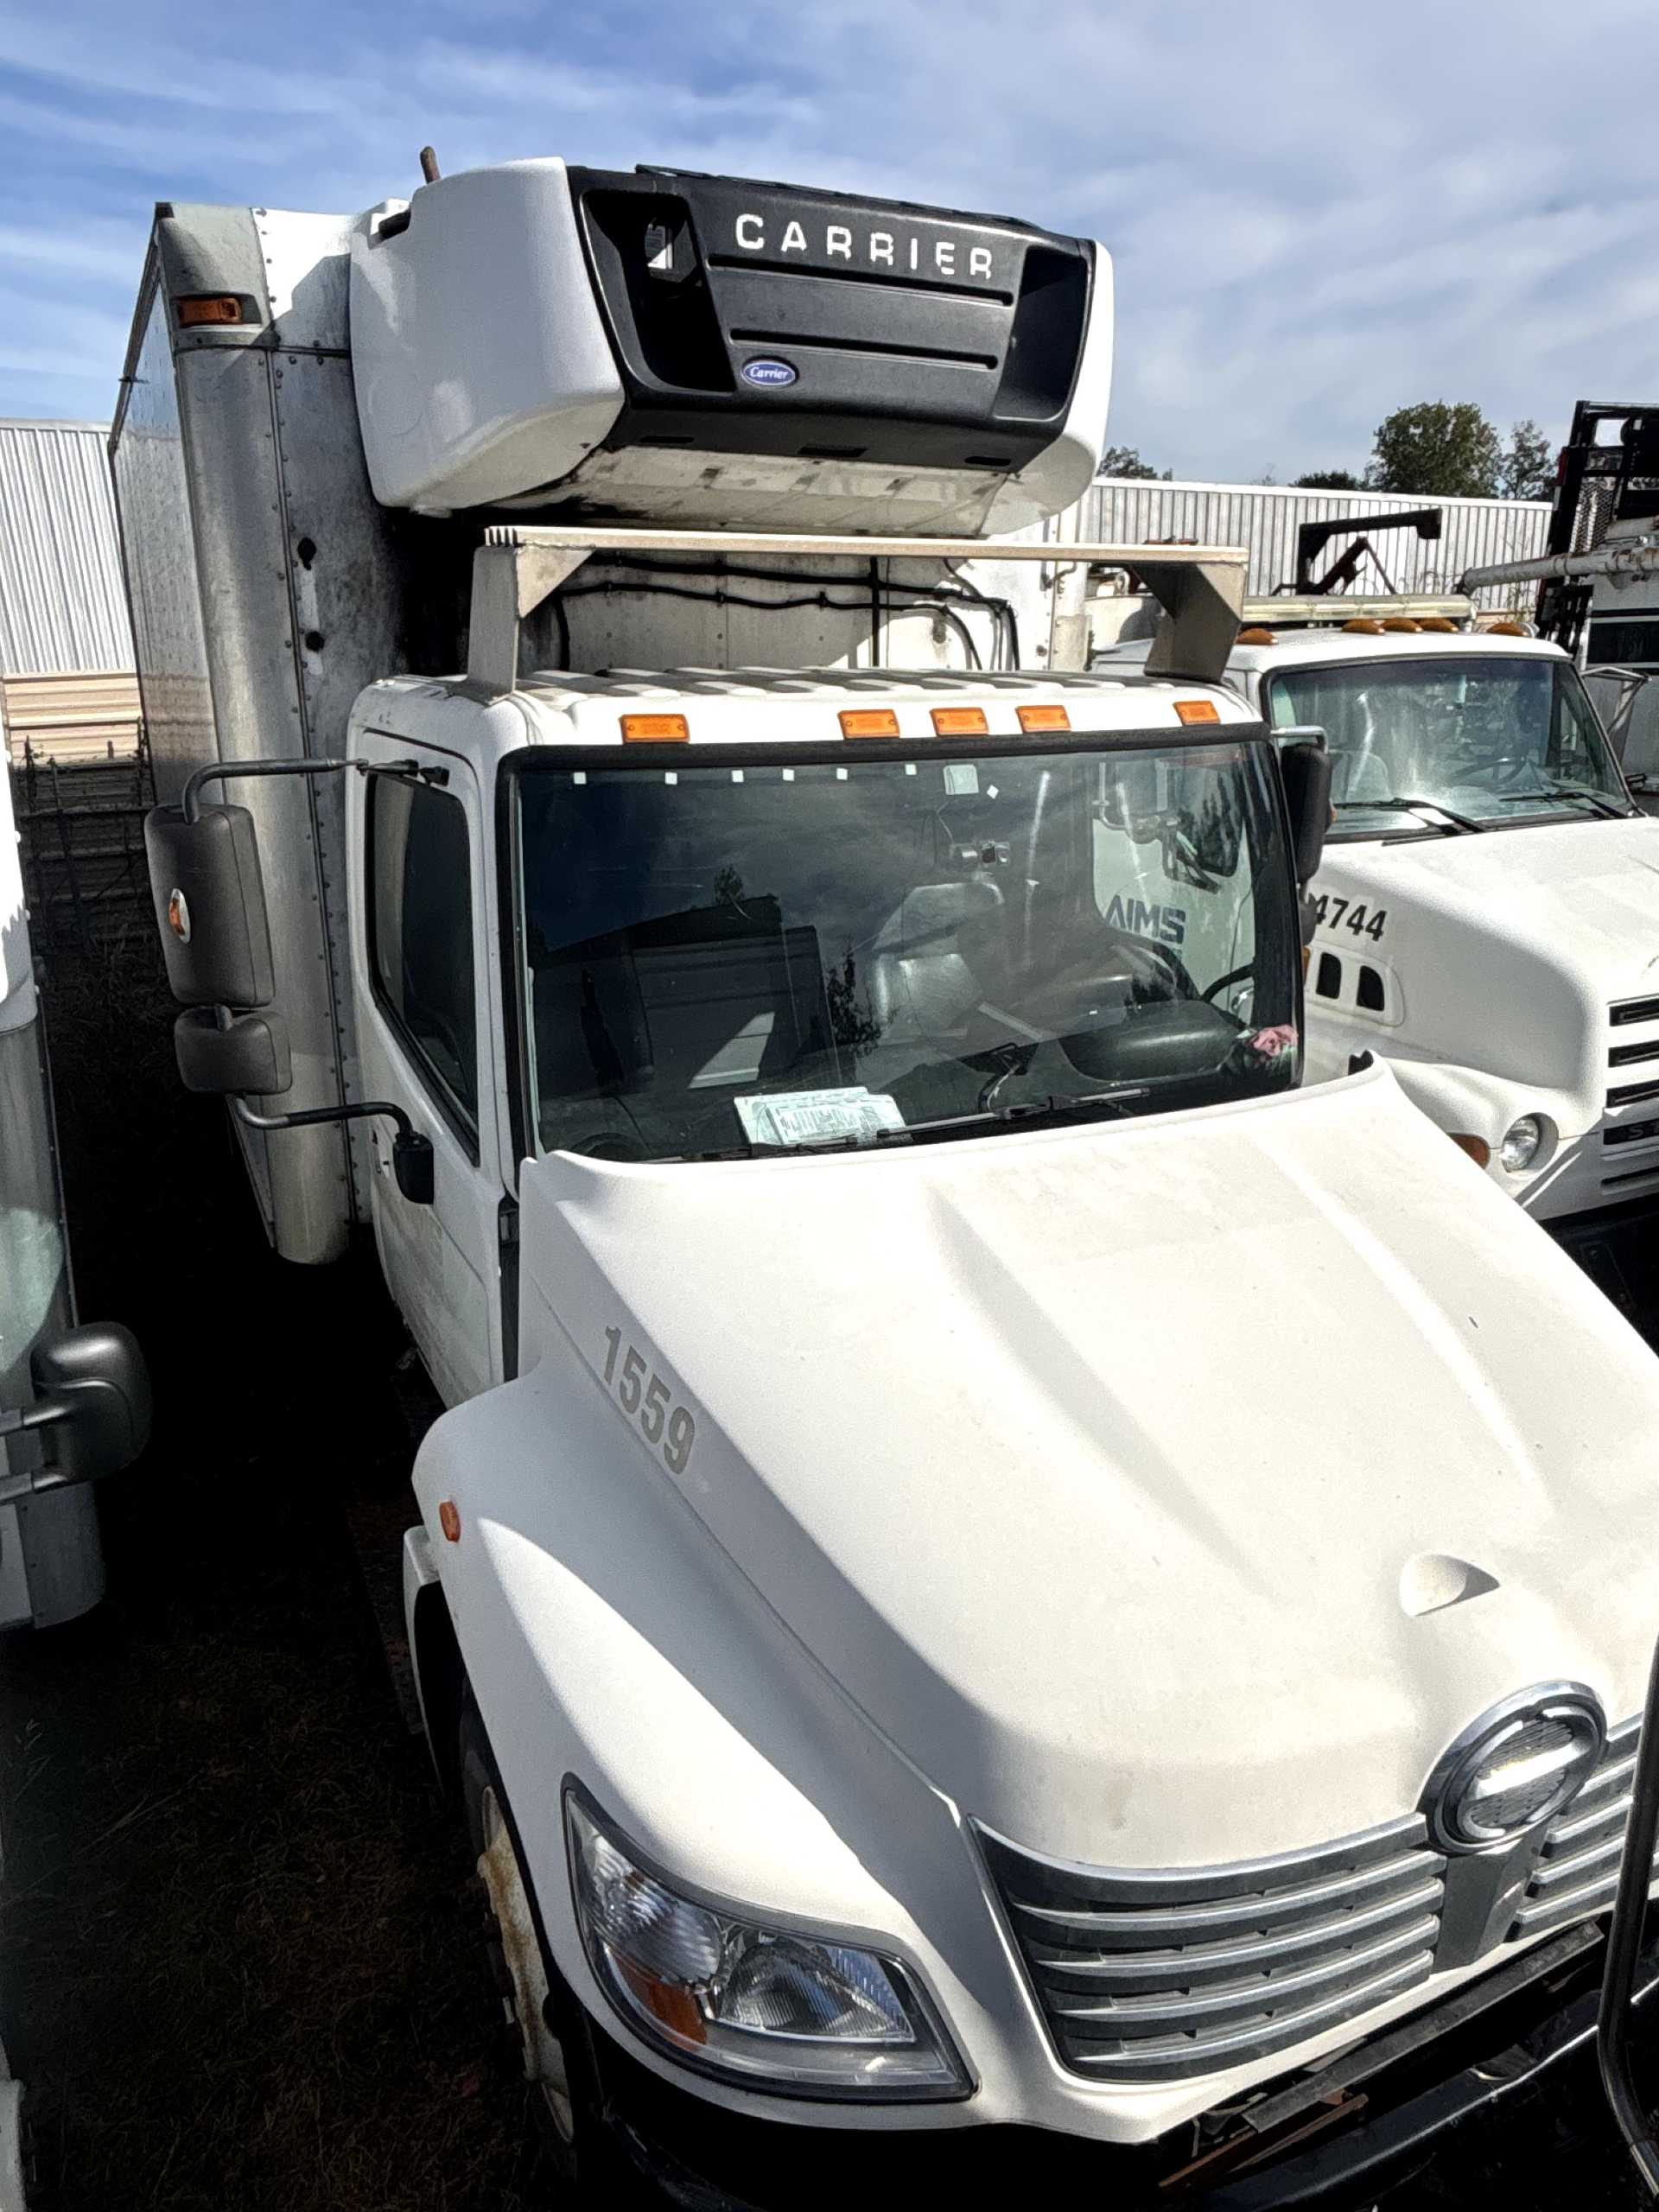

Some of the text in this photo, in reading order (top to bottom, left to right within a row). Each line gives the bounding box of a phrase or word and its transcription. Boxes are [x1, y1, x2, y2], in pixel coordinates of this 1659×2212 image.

[736, 213, 992, 279] CARRIER
[750, 366, 788, 379] Carrier
[1107, 895, 1185, 944] AIMS
[1314, 894, 1387, 941] 4744
[604, 1325, 695, 1474] 1559
